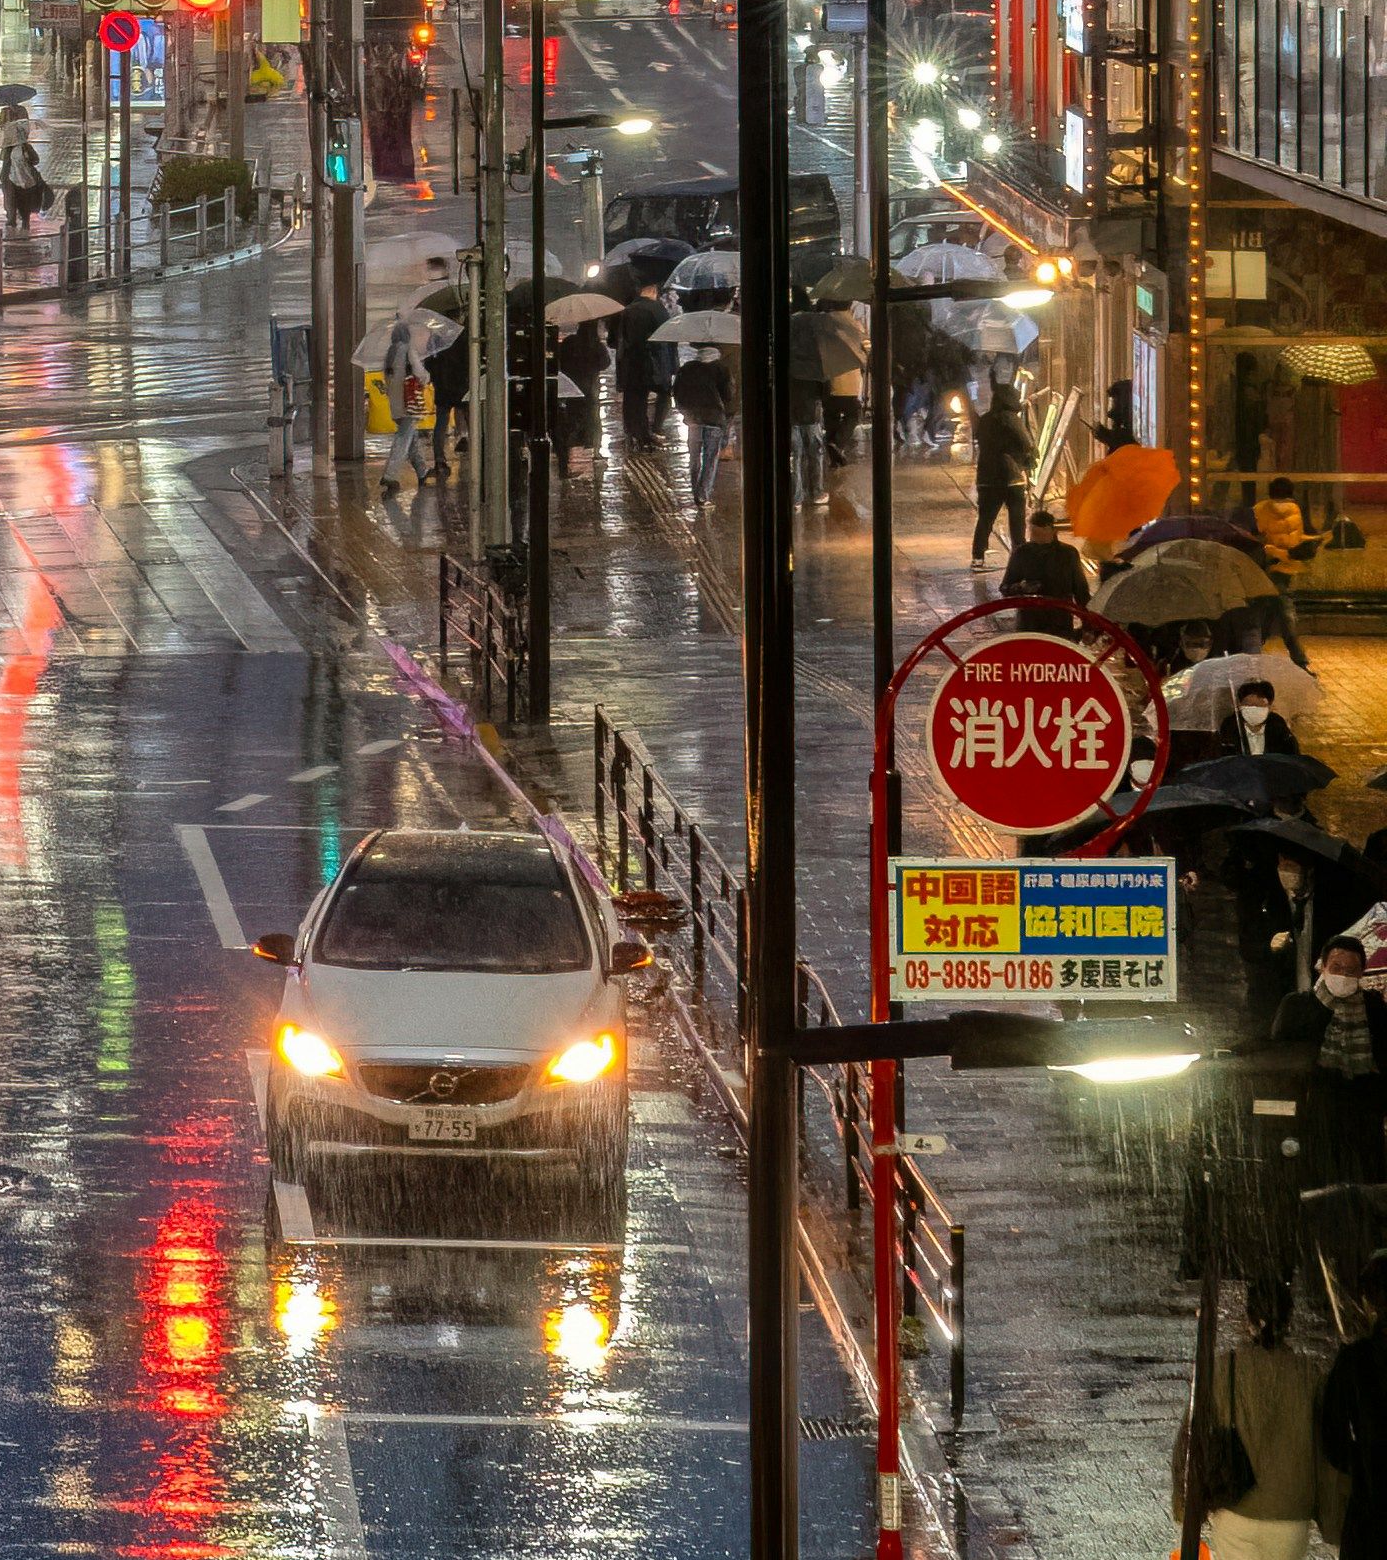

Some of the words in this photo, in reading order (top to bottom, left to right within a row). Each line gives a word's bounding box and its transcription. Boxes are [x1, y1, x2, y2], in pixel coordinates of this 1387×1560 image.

[964, 663, 1003, 682] FIRE
[1010, 663, 1092, 683] HYDRANT
[949, 697, 1112, 770] 消火栓
[906, 872, 1016, 906] 中国語
[924, 915, 999, 948] 対応
[1024, 905, 1165, 938] 協和医院
[905, 959, 1054, 989] 03-3835-0186
[1060, 959, 1165, 989] 多慶屋そば
[423, 1119, 473, 1140] 77-55
